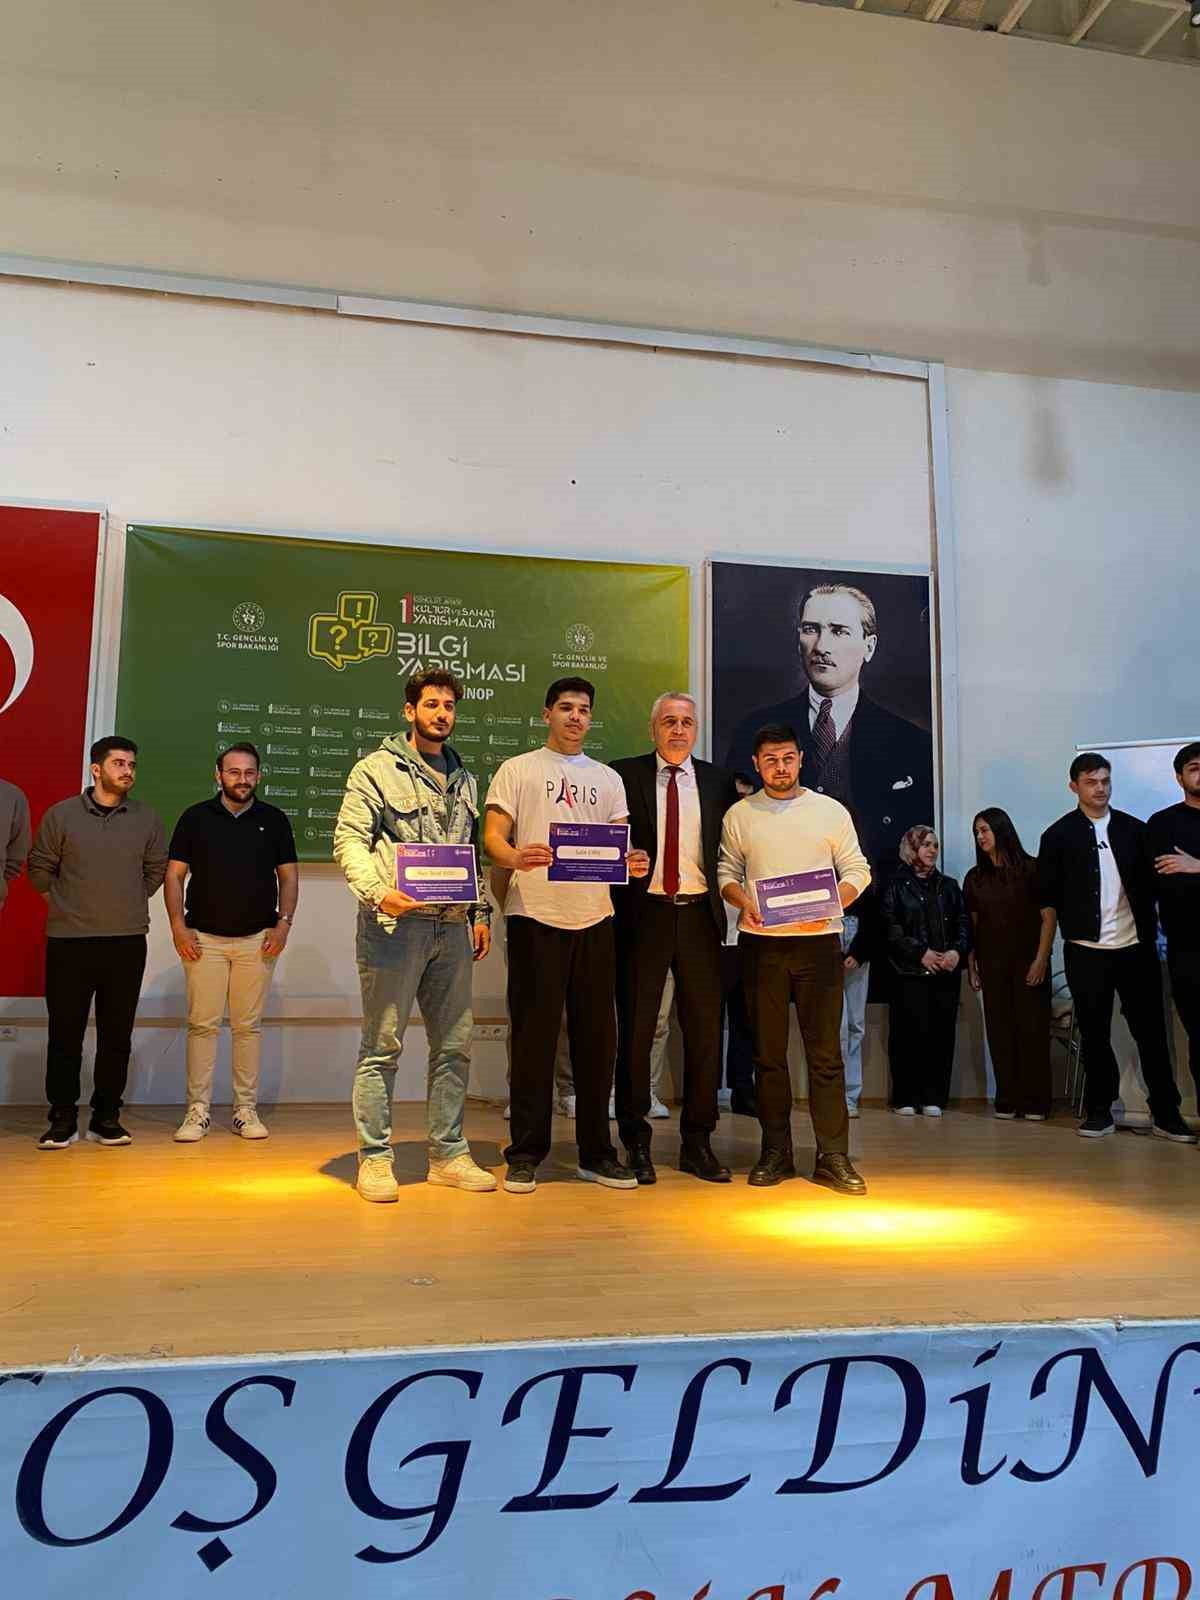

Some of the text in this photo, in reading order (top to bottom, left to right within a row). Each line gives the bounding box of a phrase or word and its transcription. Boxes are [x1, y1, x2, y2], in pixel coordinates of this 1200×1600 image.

[462, 607, 496, 618] SANAT
[397, 632, 469, 658] BİLGİ
[462, 684, 494, 700] İNOP
[546, 777, 597, 808] PARIS
[0, 1373, 297, 1573] OŞ
